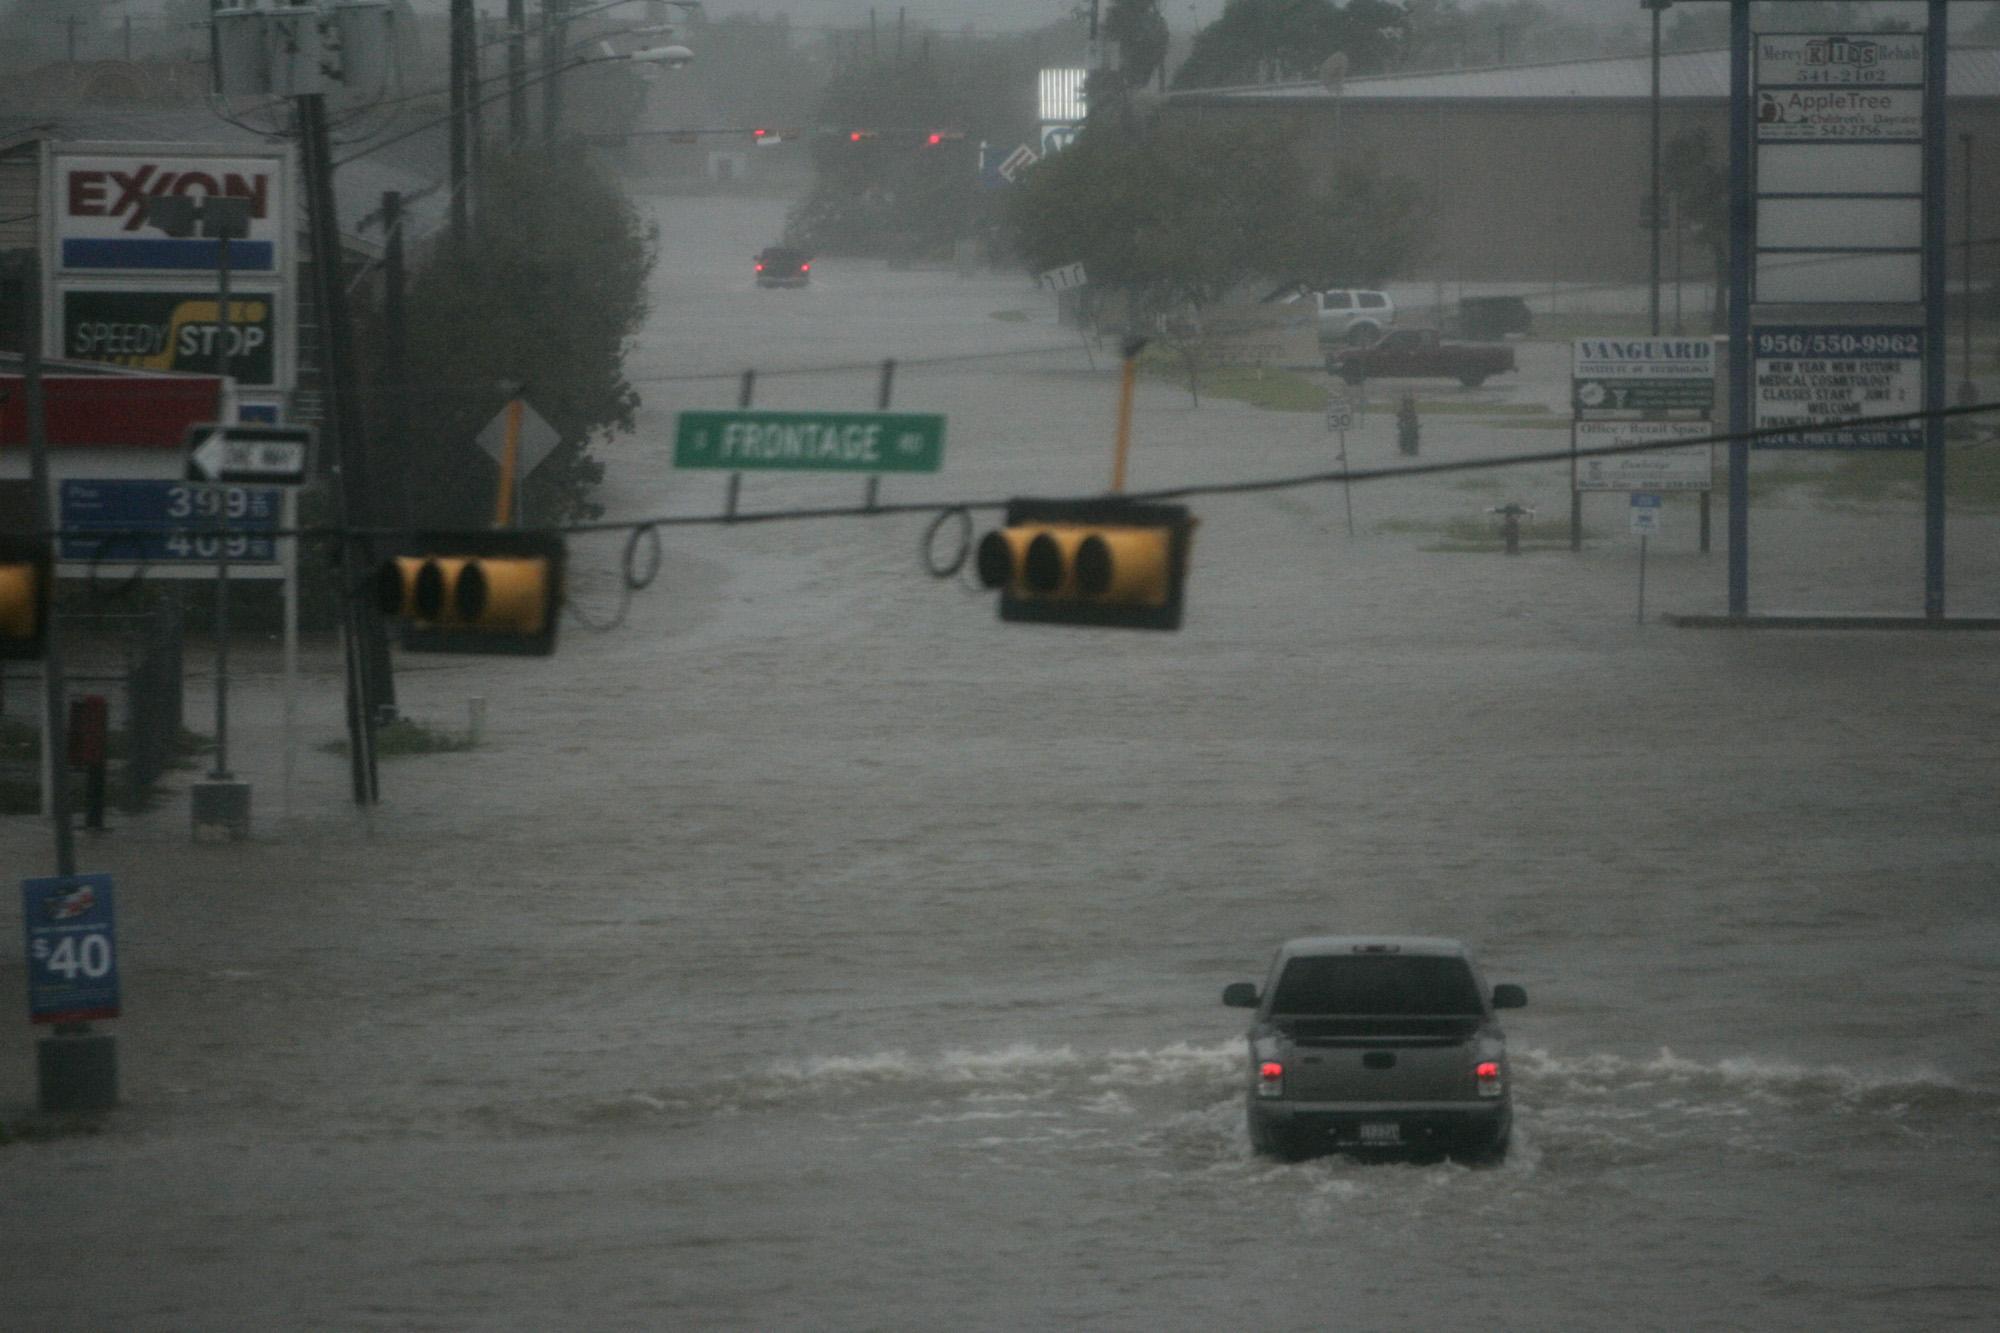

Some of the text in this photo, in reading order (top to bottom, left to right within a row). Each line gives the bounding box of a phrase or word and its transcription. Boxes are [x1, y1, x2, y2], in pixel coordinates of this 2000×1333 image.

[1809, 44, 1875, 63] KIDS
[1797, 69, 1886, 81] 541-2102
[1788, 93, 1891, 111] AppleTree
[1809, 114, 1866, 124] Children's
[76, 323, 265, 357] SPEEDY STOP
[1758, 335, 1919, 355] 956/550-9962
[1581, 341, 1711, 359] VANGUARD
[1816, 388, 1851, 400] START
[1330, 414, 1351, 428] 30
[720, 421, 883, 462] FRONTAGE
[167, 487, 248, 518] 399
[31, 933, 111, 979] $40
